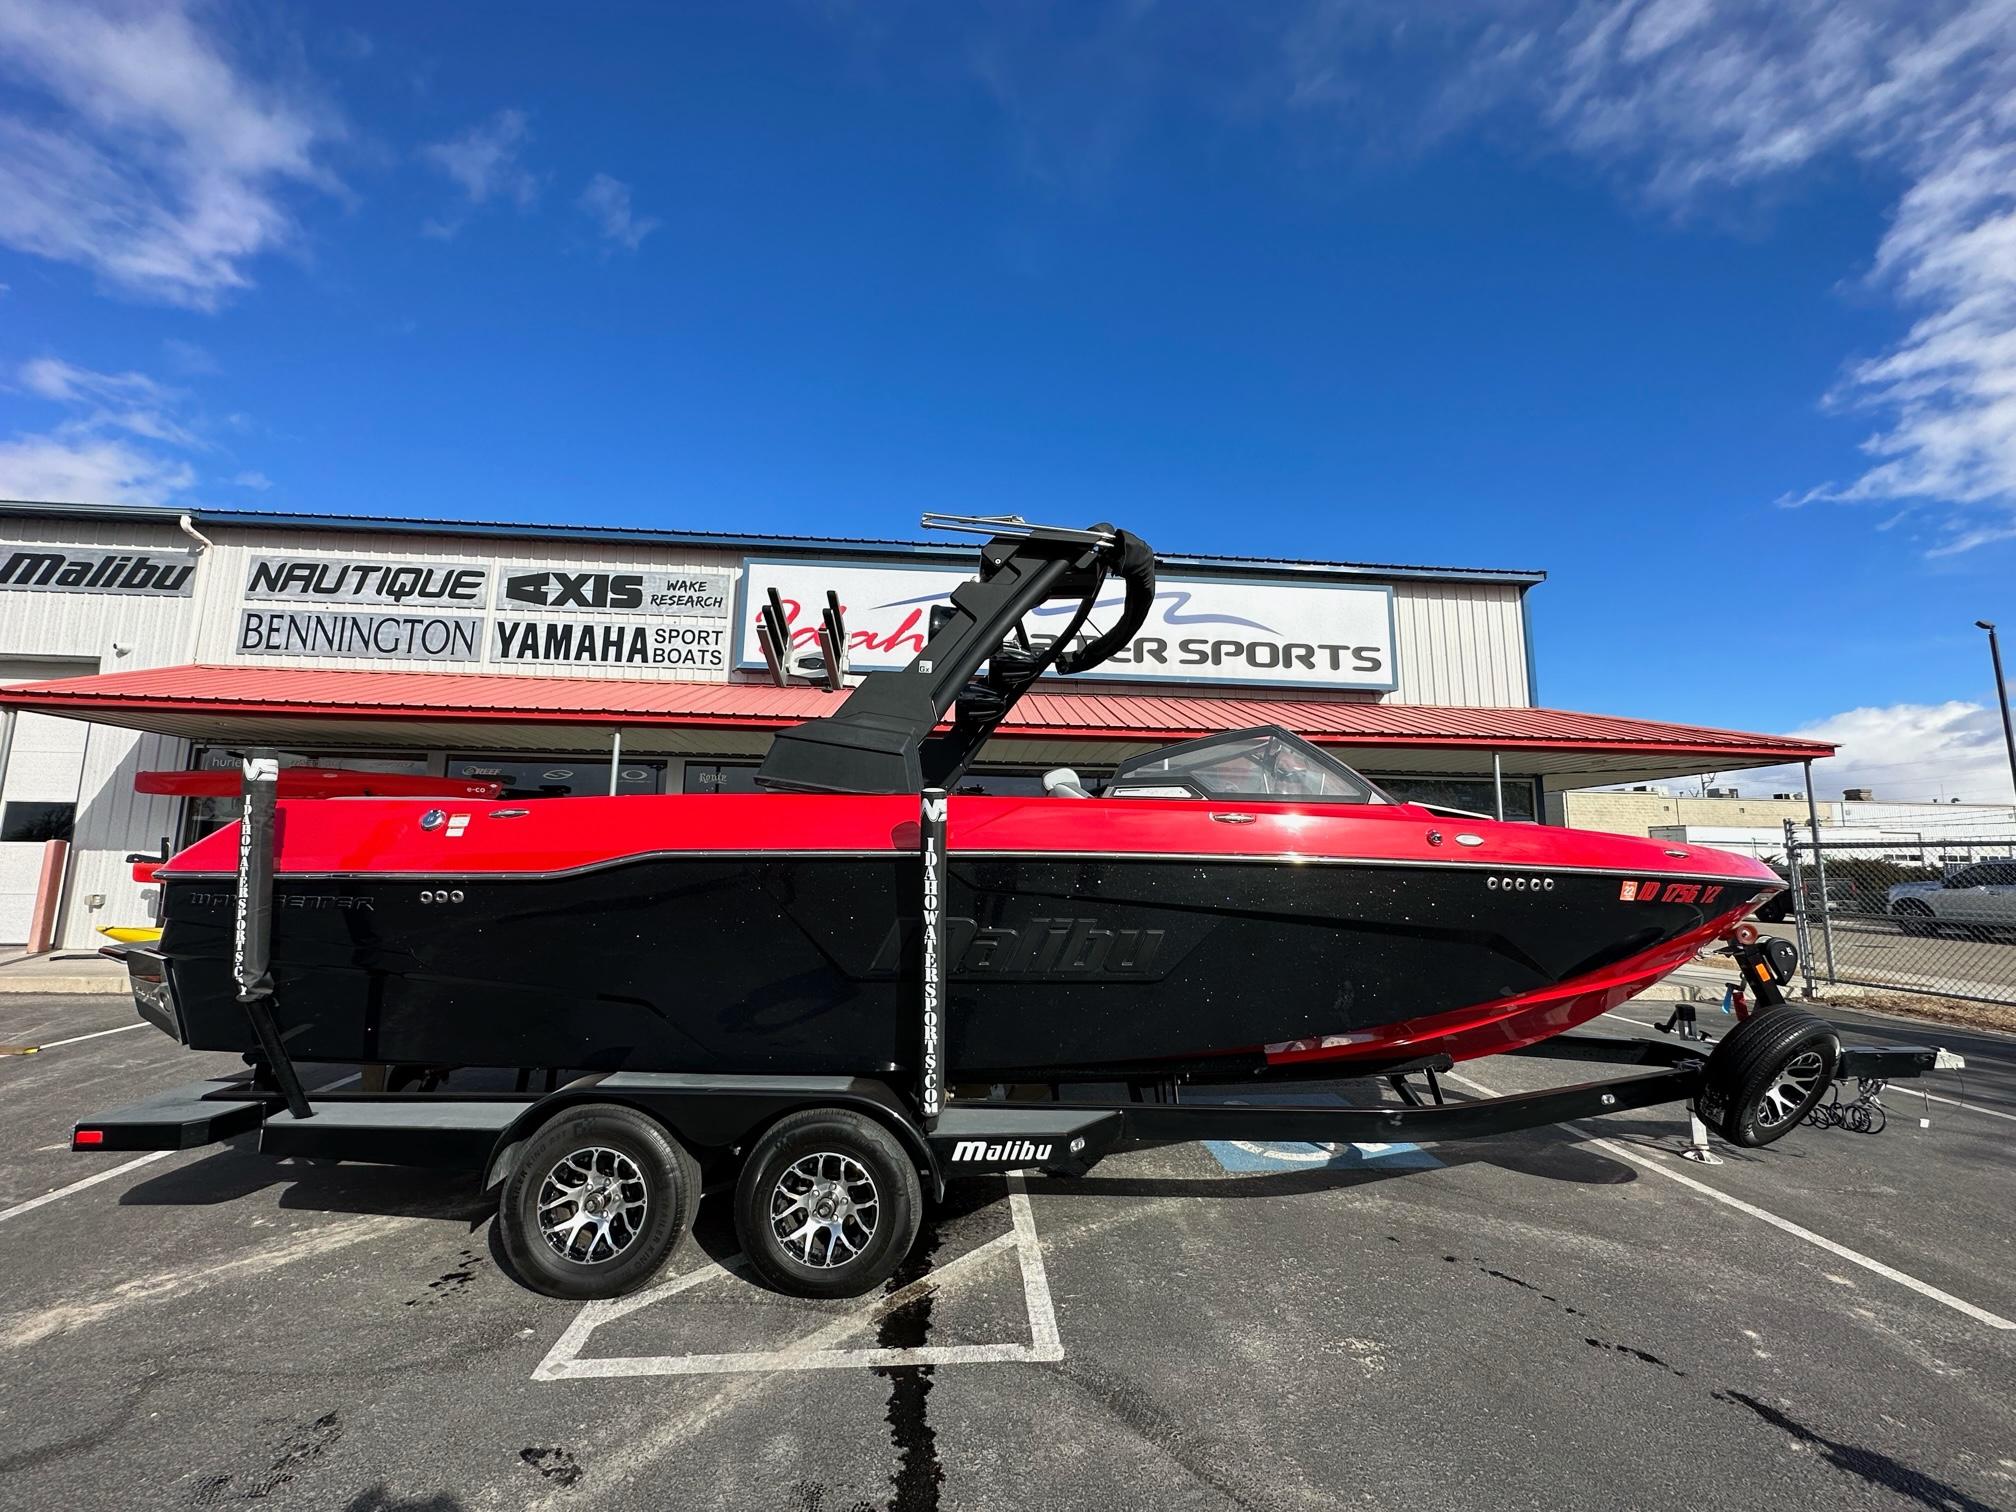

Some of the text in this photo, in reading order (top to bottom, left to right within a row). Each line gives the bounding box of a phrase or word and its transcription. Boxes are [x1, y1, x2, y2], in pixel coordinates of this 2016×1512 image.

[0, 553, 195, 590] Malibu
[248, 561, 486, 602] NAUTIQUE
[505, 571, 643, 609] AXIS
[666, 579, 707, 593] WAKE
[650, 593, 723, 608] RESEARCH
[241, 613, 477, 656] BENNINGTON
[497, 621, 649, 663] YAMAHA
[654, 628, 723, 646] SPORT
[755, 599, 924, 655] Idah
[1178, 638, 1382, 672] SPORTS
[652, 647, 722, 666] BOATS
[212, 757, 242, 768] hurle
[923, 837, 939, 1114] IDAHOWATERSPORTS.COM
[951, 1140, 1052, 1161] Malibu
